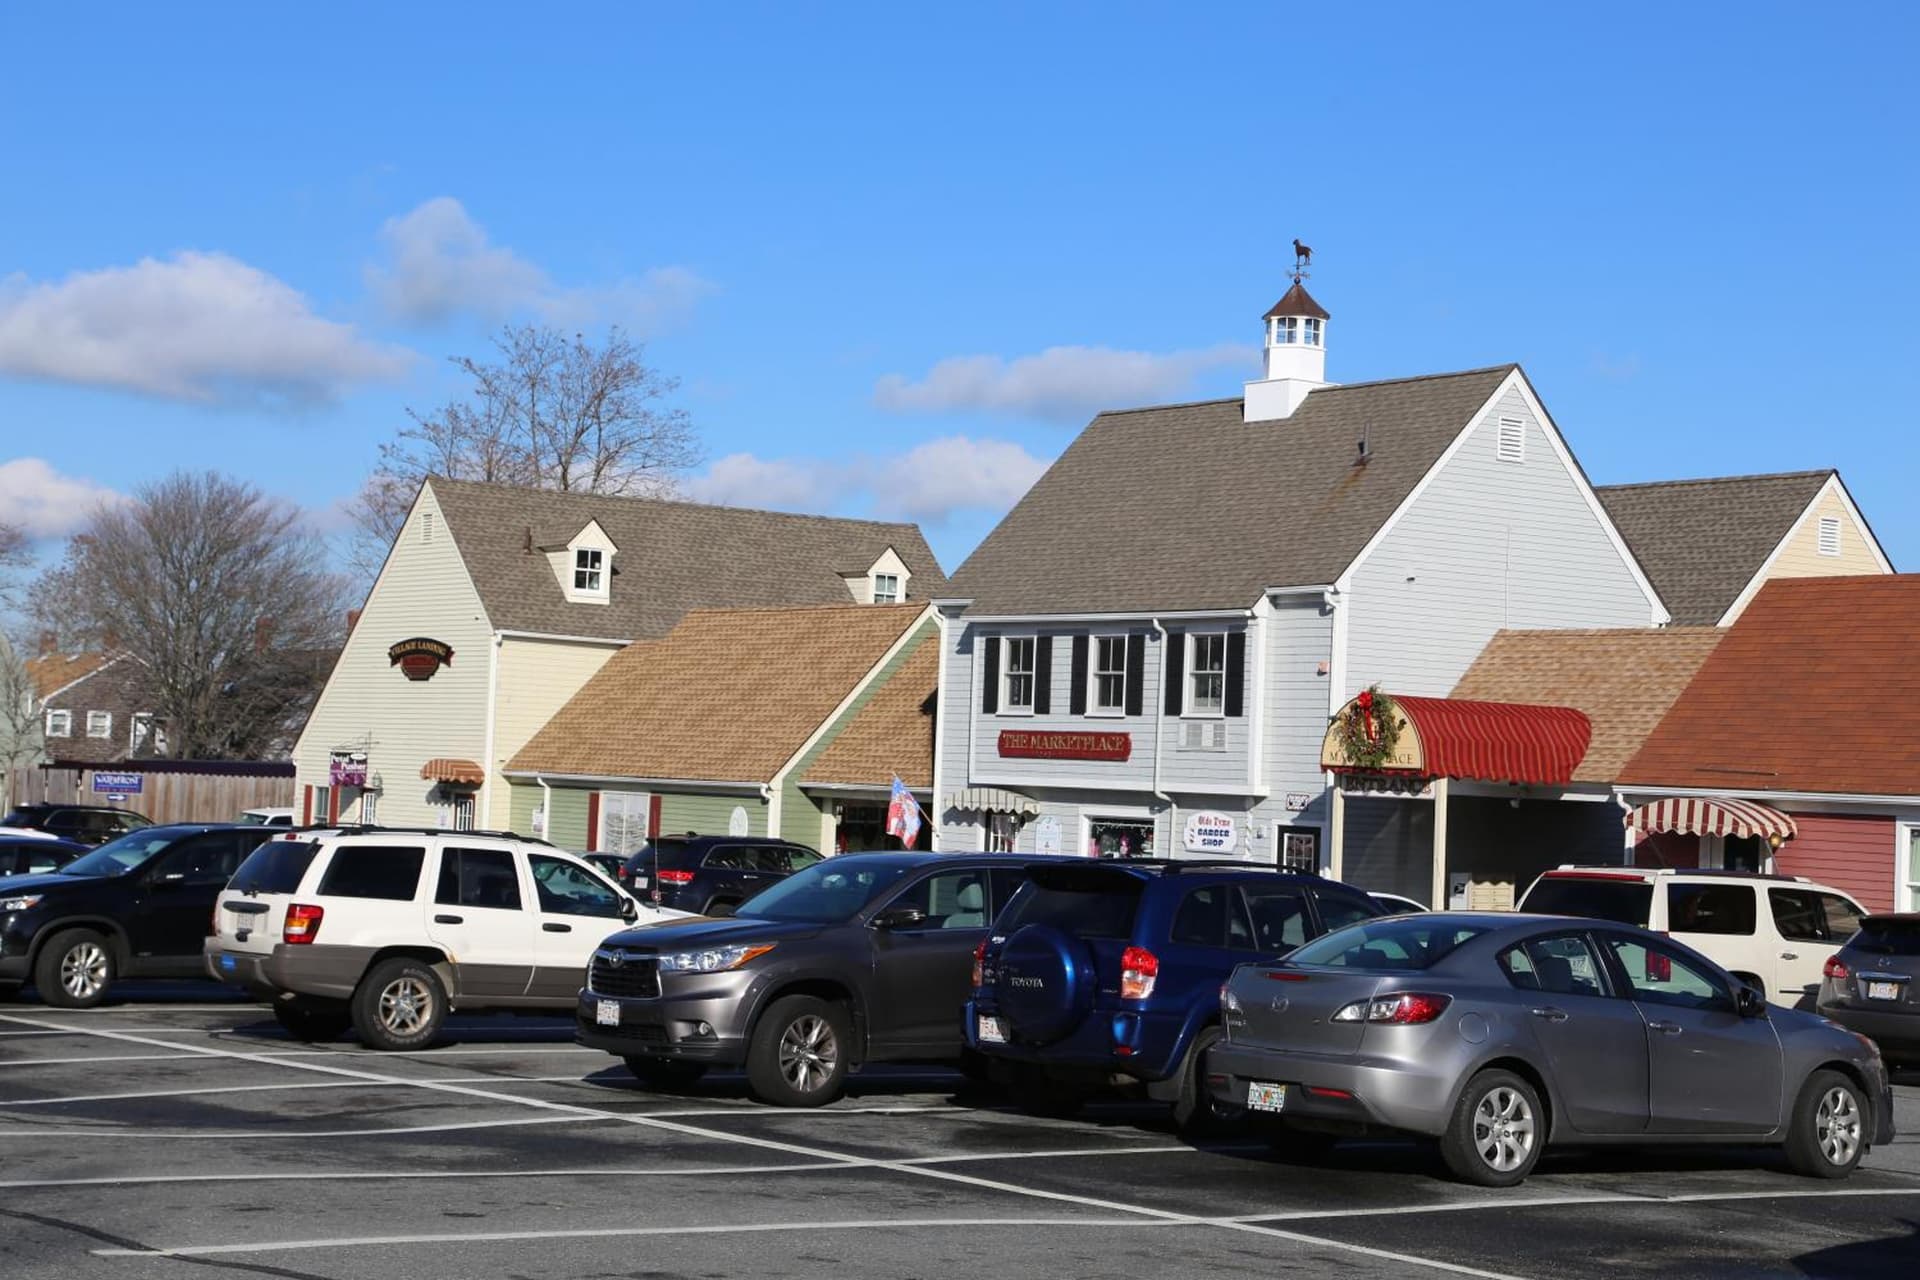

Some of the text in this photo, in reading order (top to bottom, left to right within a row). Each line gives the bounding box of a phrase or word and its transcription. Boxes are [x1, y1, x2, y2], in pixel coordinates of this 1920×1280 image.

[1002, 733, 1125, 751] THE MARKETPLACE
[340, 760, 367, 771] Pusher
[1197, 828, 1230, 838] BARBER
[1201, 838, 1225, 847] SHOP
[1011, 976, 1044, 988] TOYOTA
